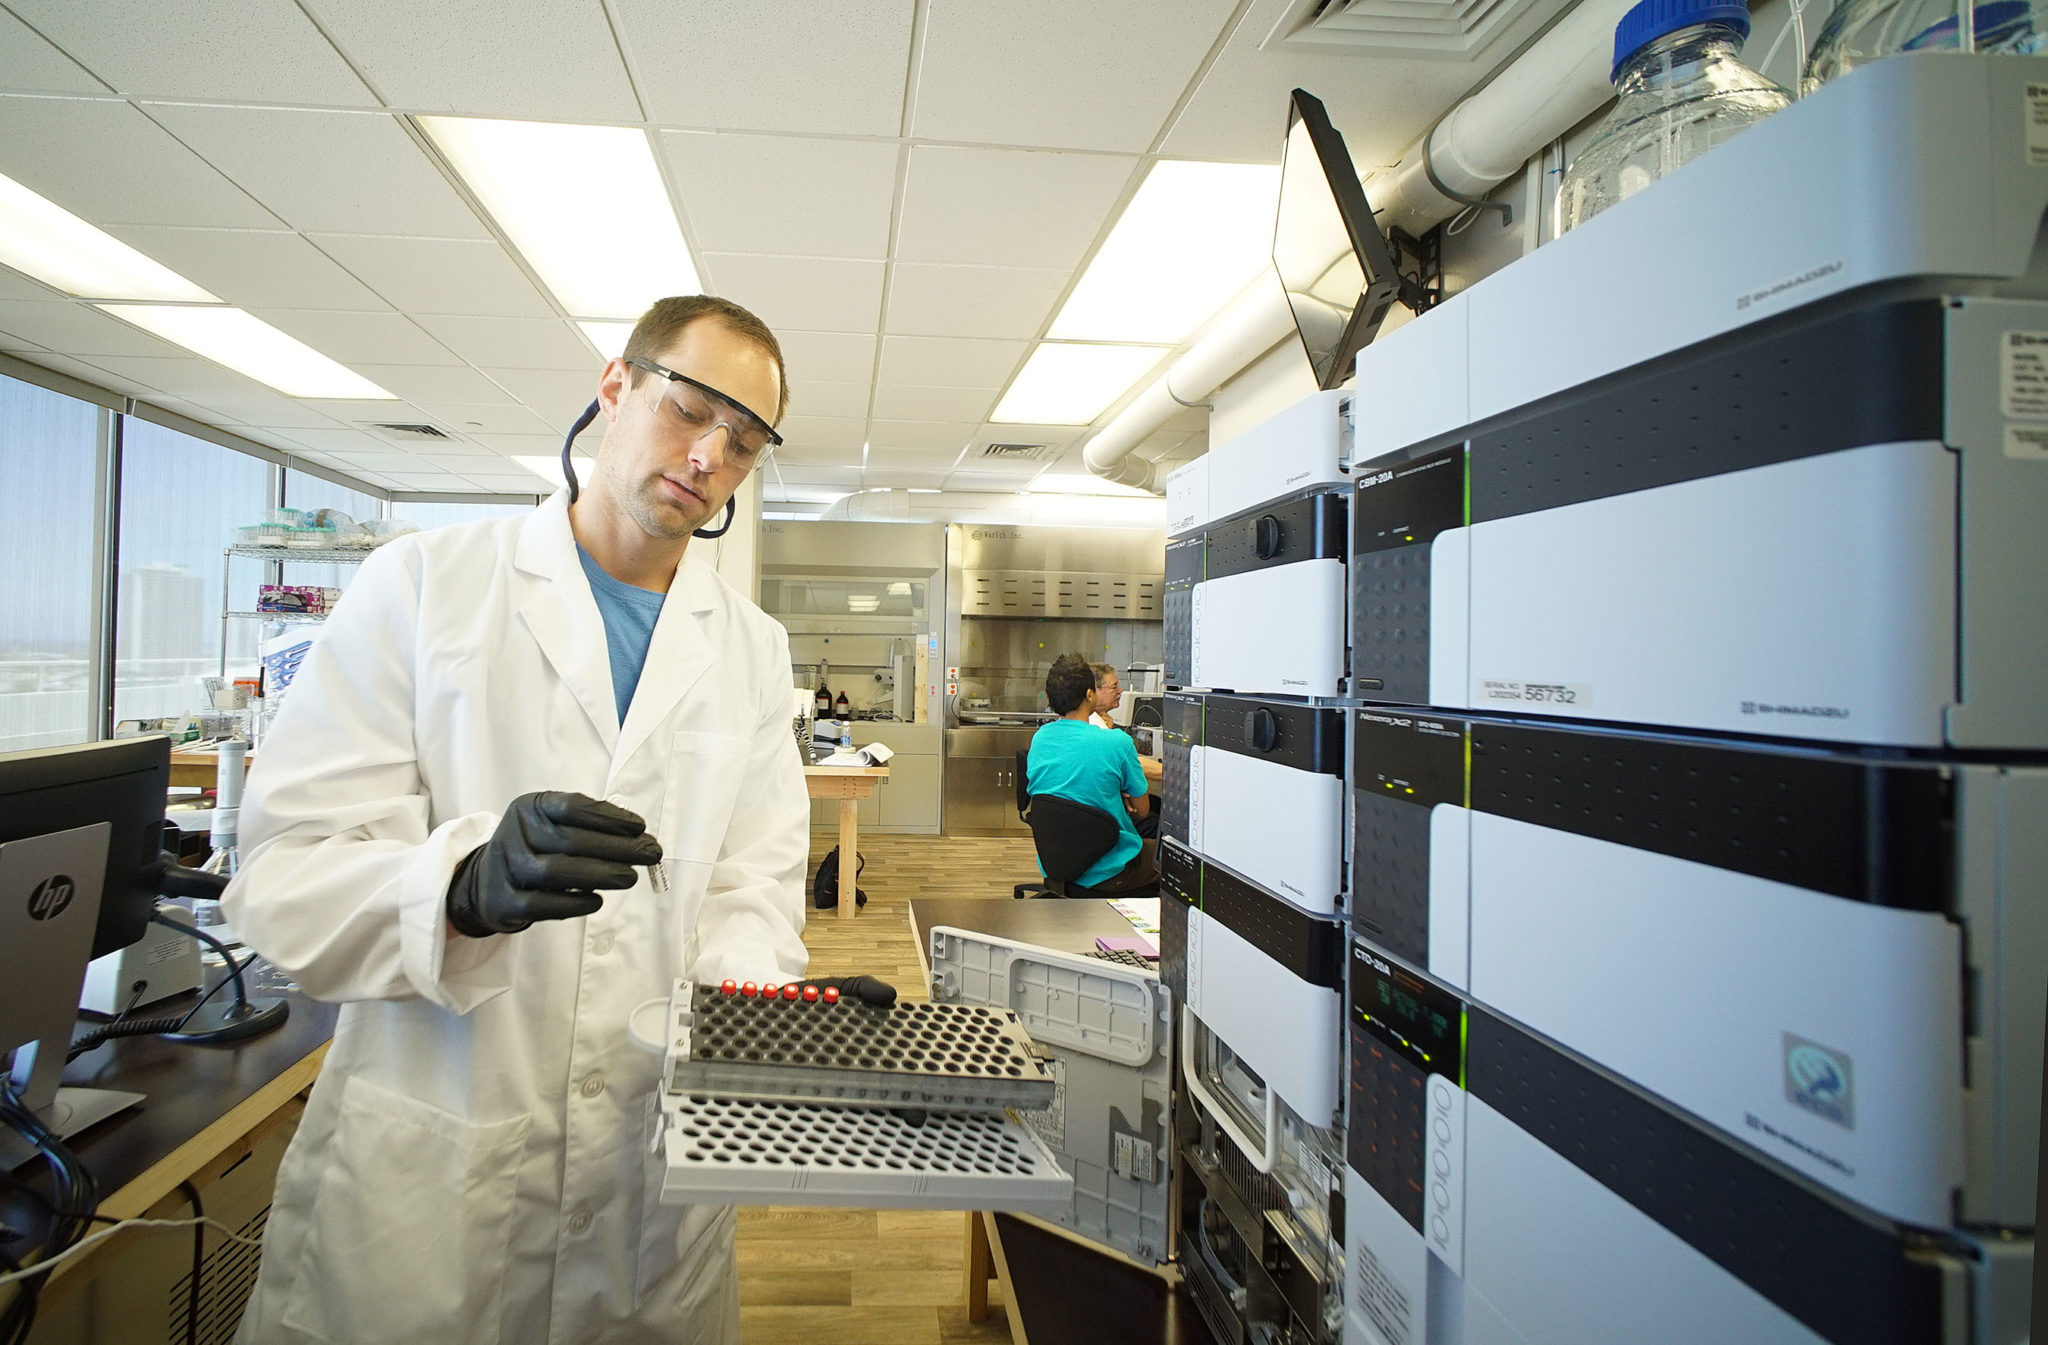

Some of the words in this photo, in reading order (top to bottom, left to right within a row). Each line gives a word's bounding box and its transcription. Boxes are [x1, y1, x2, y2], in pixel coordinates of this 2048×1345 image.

[1358, 471, 1393, 489] CBM-20A
[1525, 687, 1576, 704] 56732
[33, 876, 71, 920] hp
